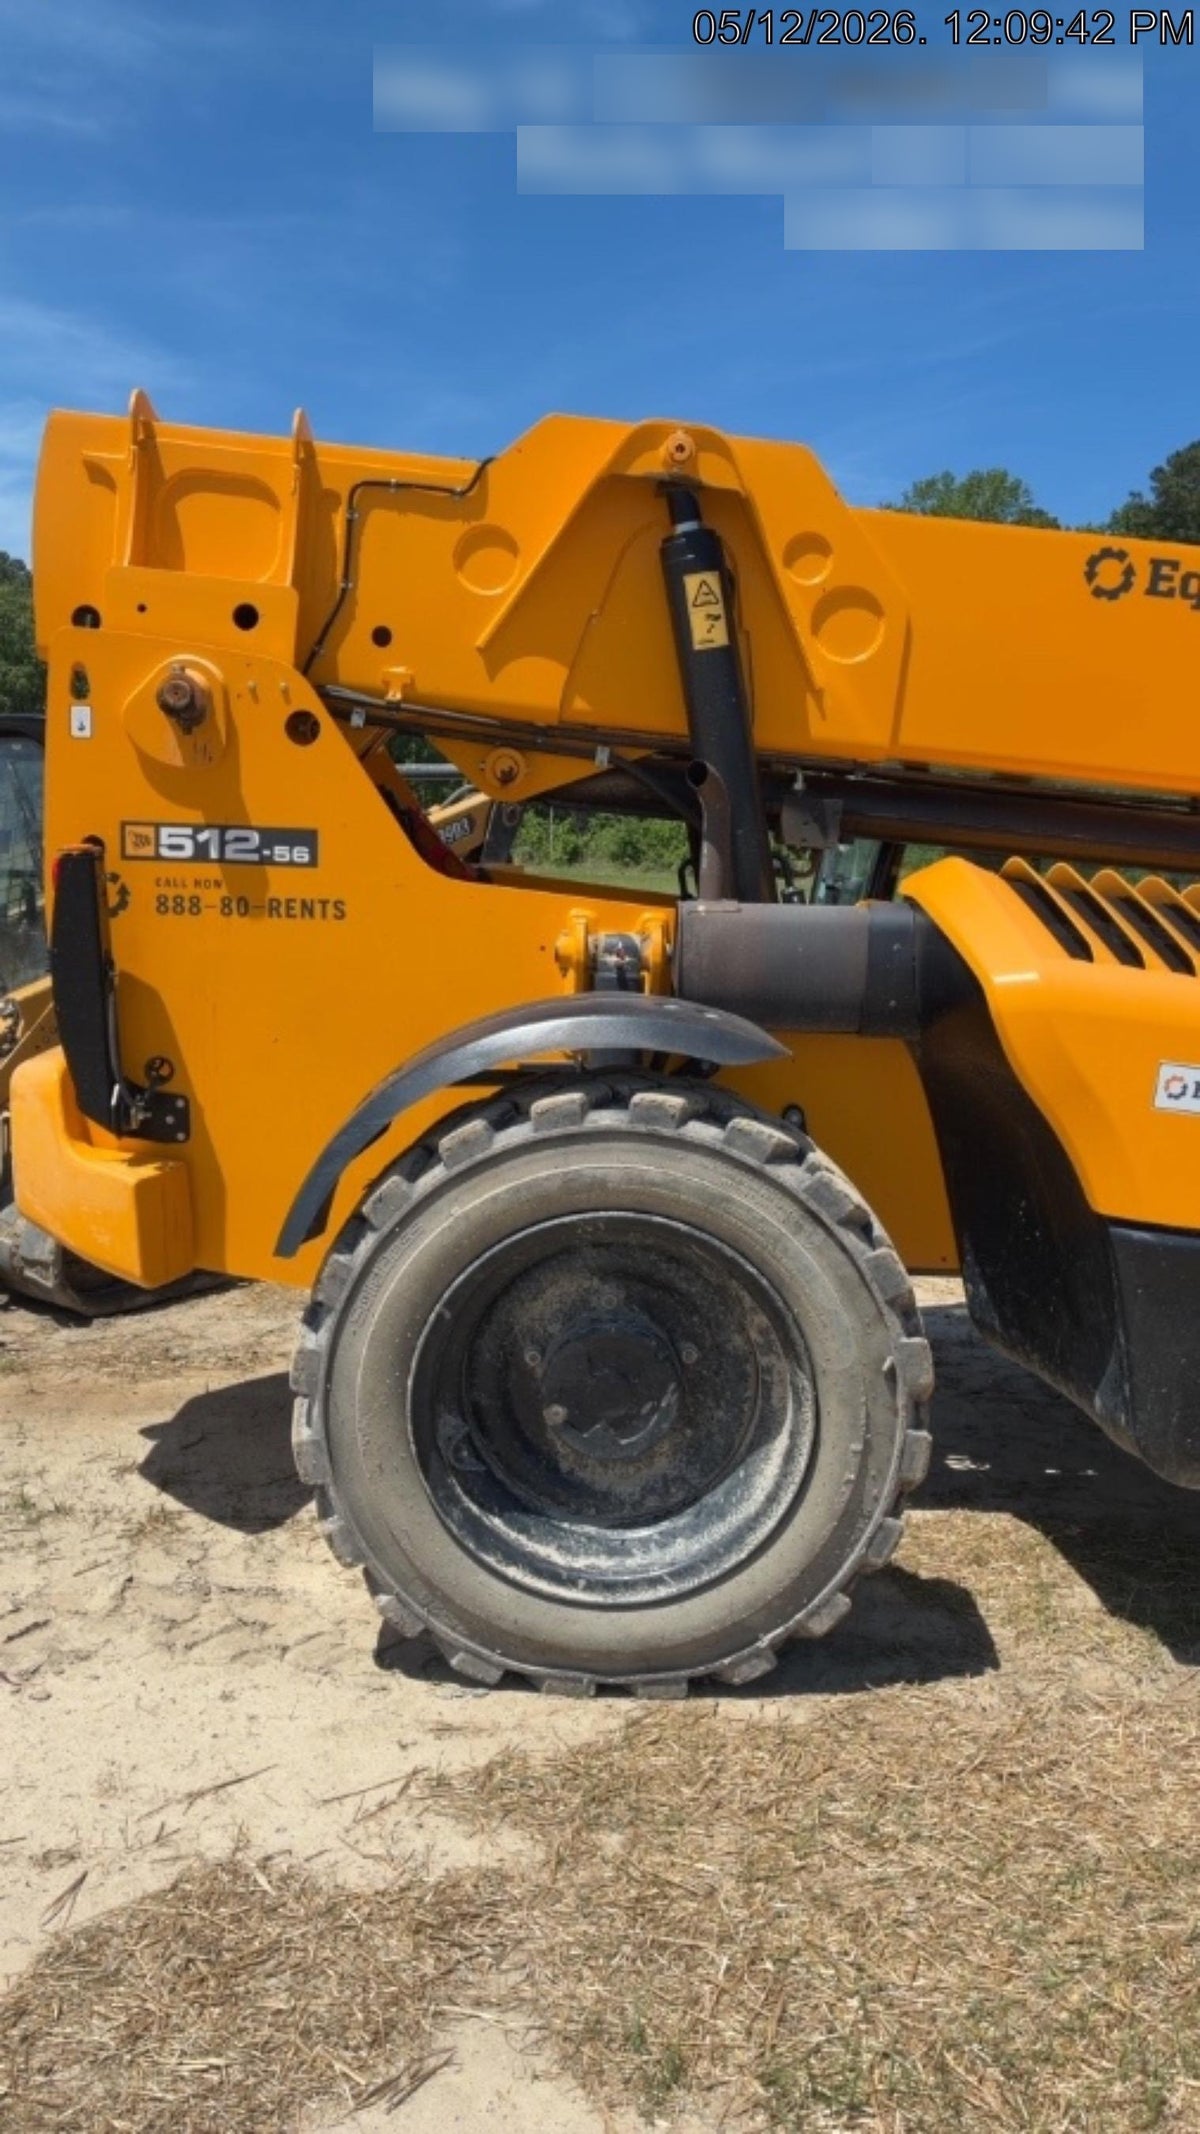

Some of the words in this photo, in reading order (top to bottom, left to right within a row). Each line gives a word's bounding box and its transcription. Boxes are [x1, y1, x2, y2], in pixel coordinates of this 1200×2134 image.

[158, 826, 310, 864] 512-56
[155, 877, 187, 889] CALL
[155, 894, 347, 921] 888-80-RENTS
